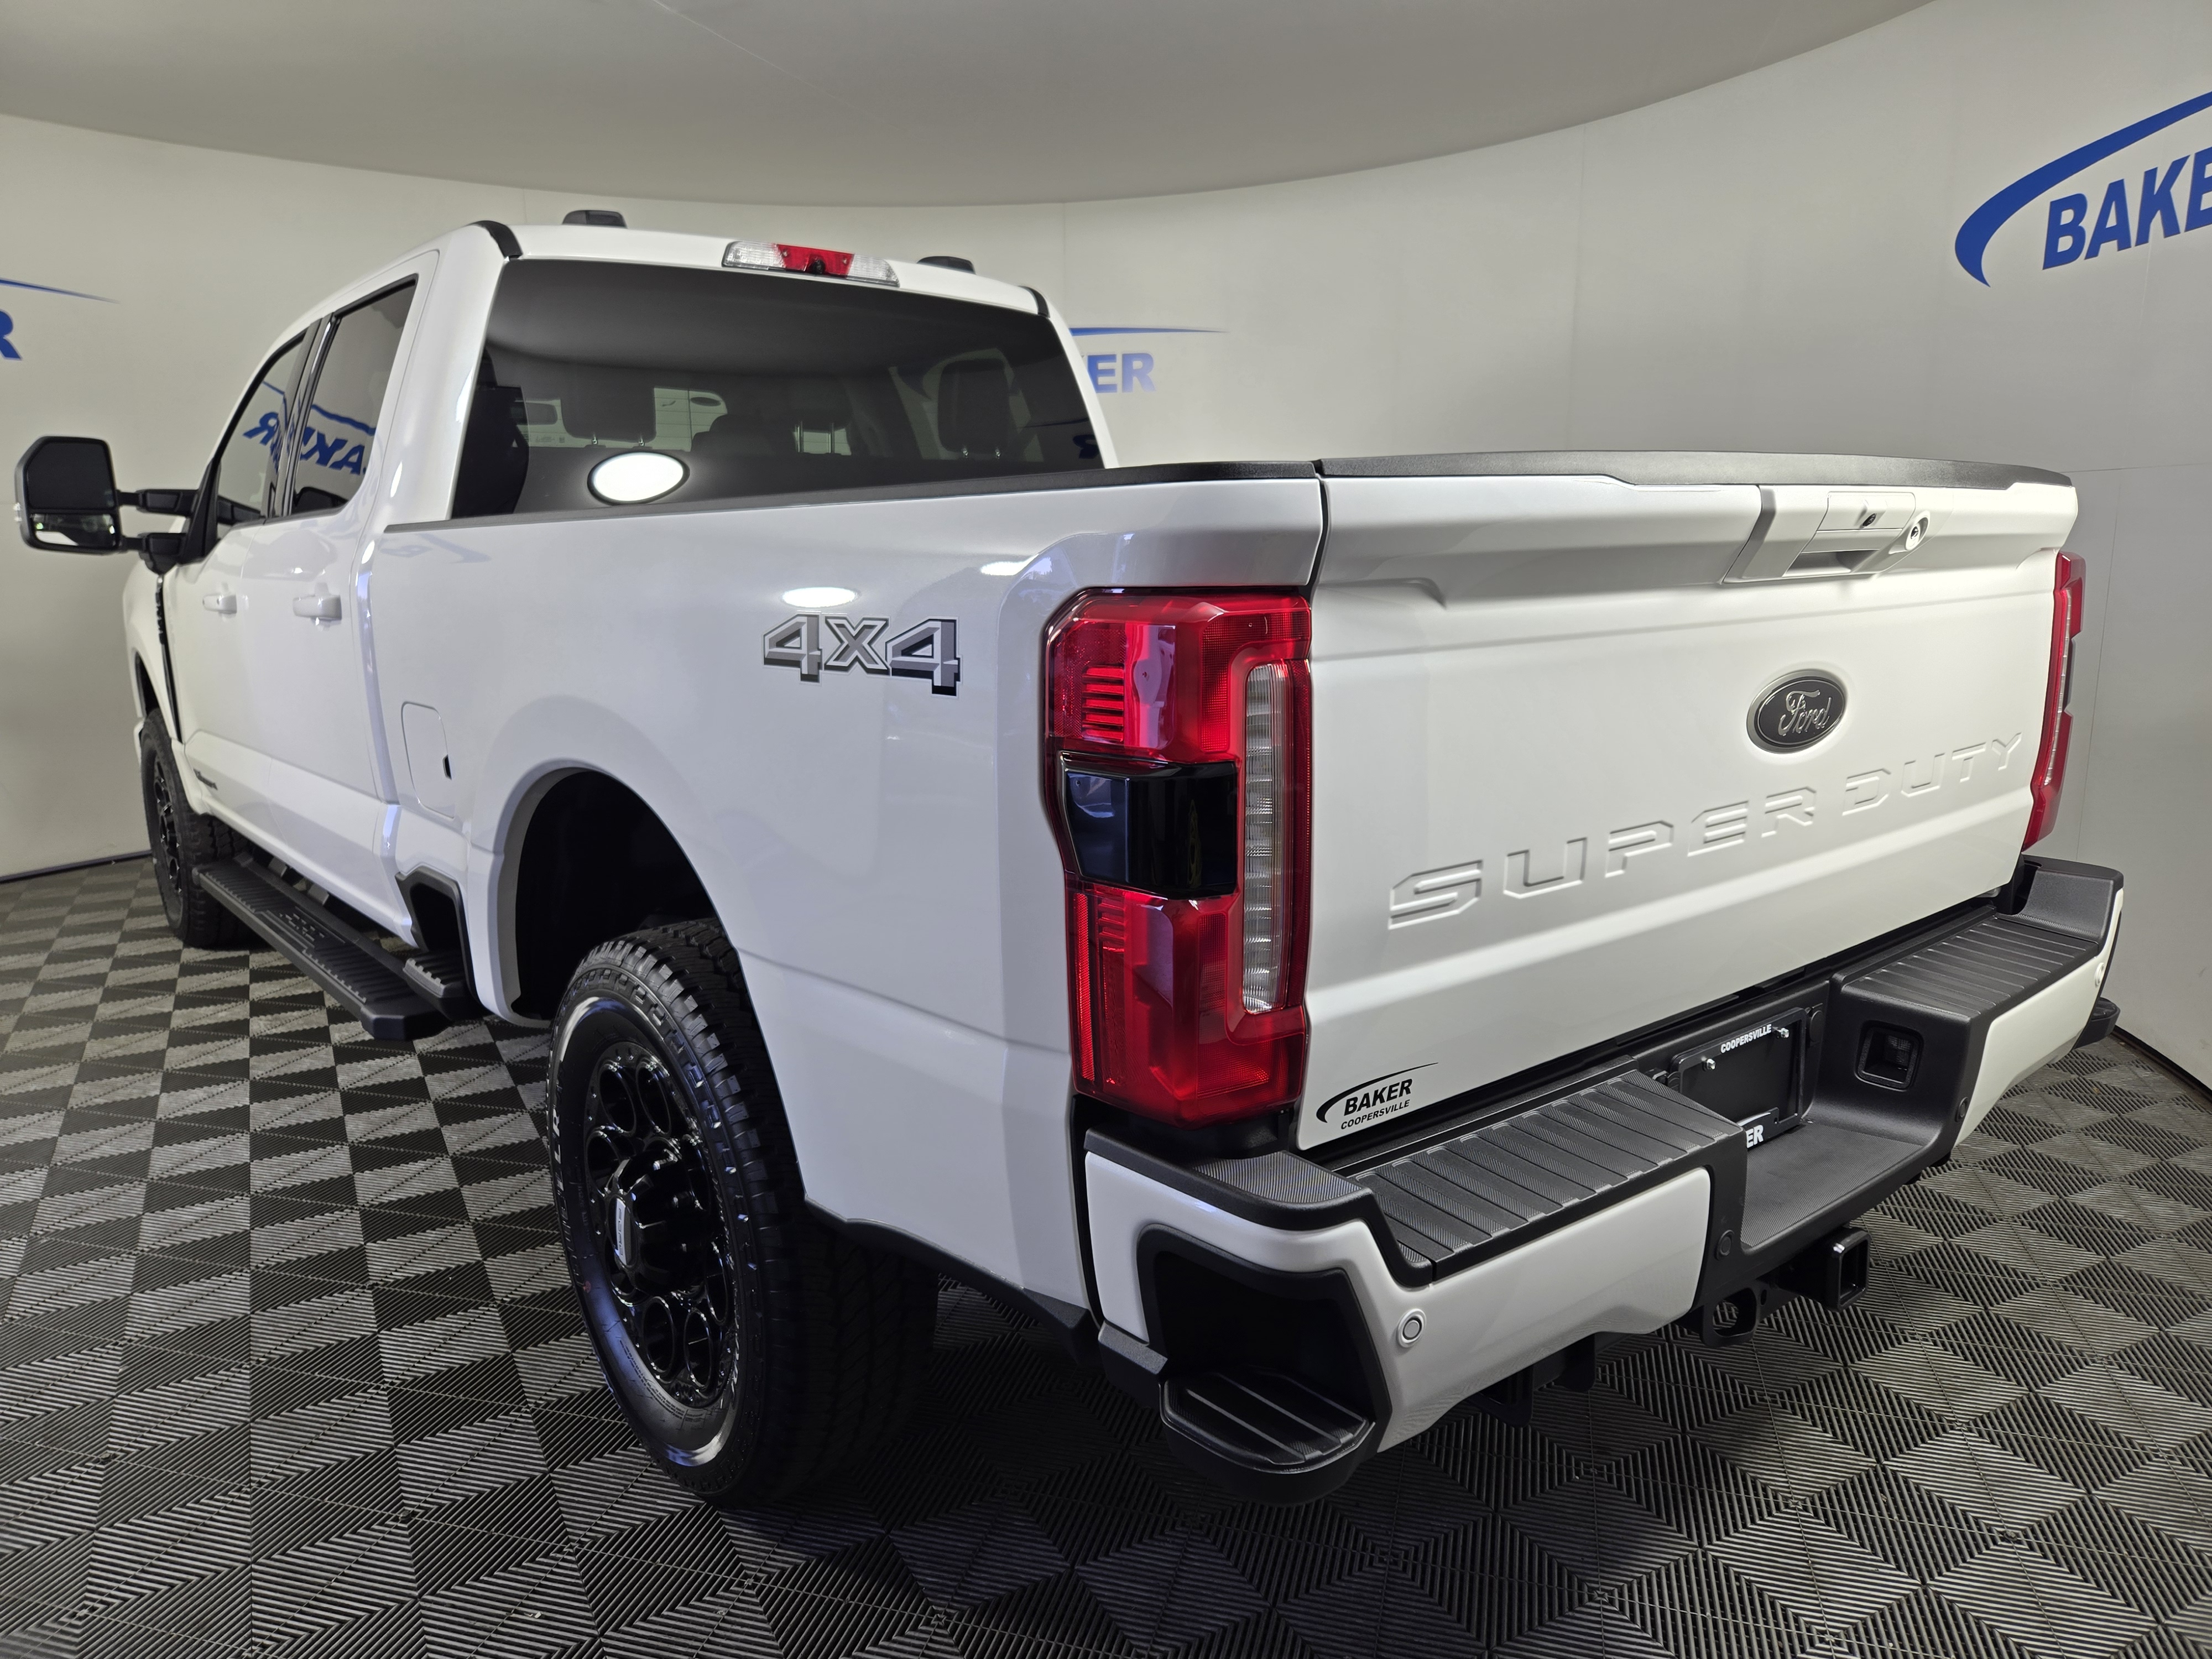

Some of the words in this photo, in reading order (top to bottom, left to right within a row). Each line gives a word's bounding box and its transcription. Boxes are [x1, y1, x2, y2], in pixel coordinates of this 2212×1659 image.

[1086, 352, 1156, 394] ER
[1778, 689, 1833, 736] Ford
[1388, 786, 1816, 929] SUPER
[1842, 732, 2022, 816] DUTY
[1720, 1024, 1772, 1053] COOPERSVILLE
[1340, 1099, 1411, 1130] COOPERSVILLE
[1343, 1078, 1413, 1117] BAKER
